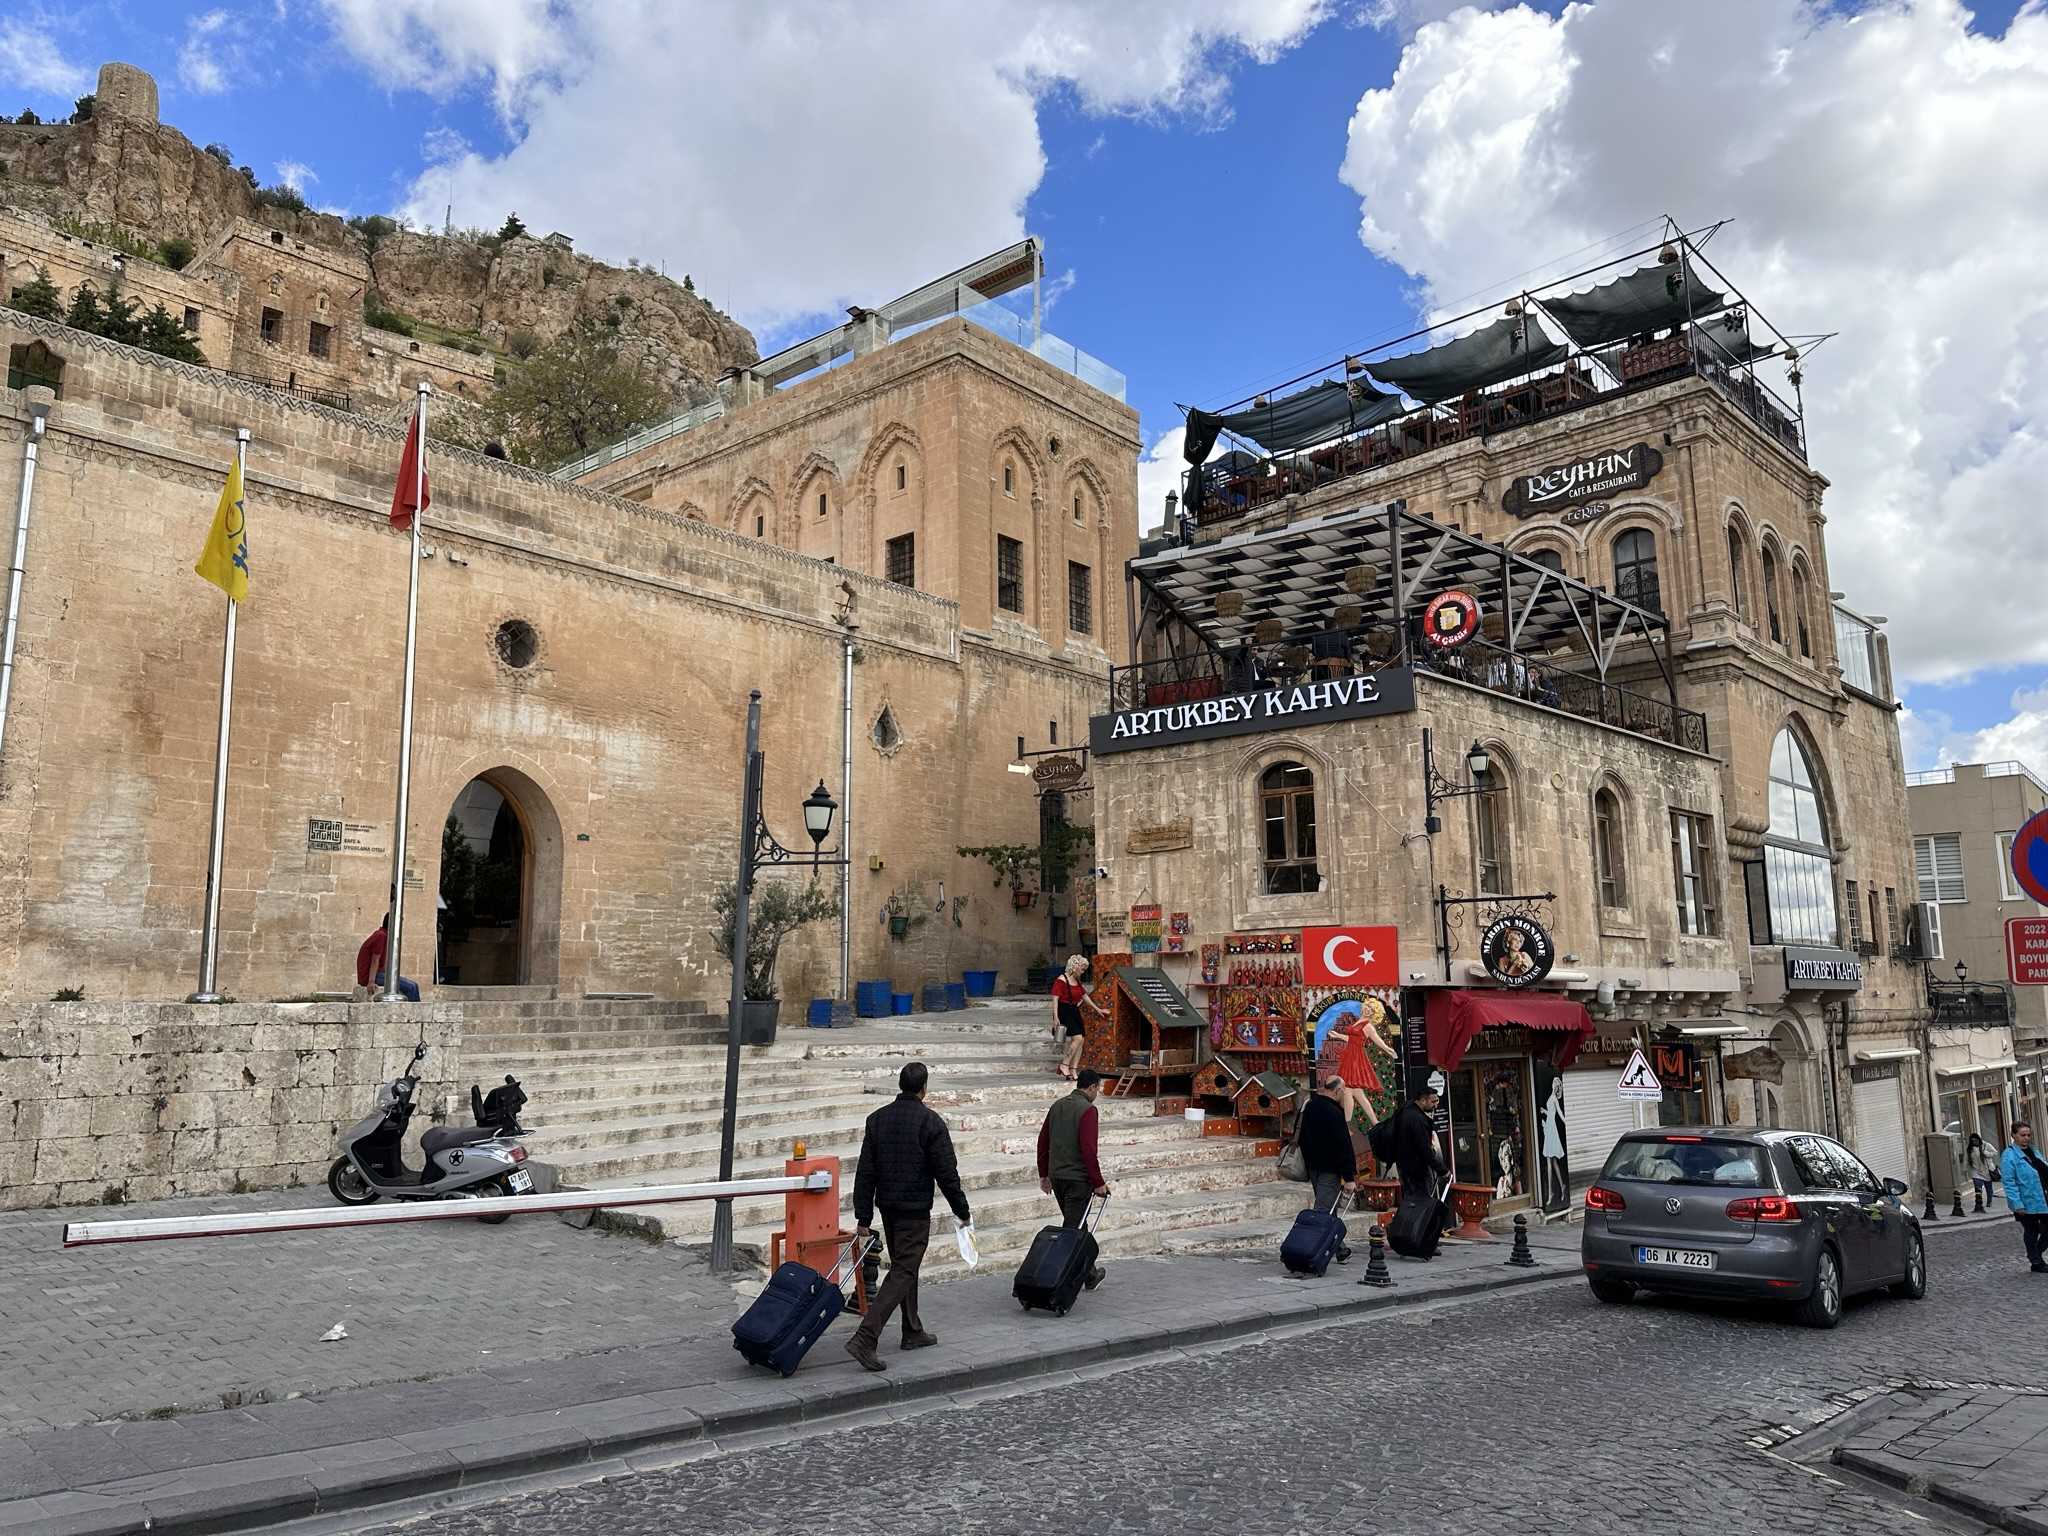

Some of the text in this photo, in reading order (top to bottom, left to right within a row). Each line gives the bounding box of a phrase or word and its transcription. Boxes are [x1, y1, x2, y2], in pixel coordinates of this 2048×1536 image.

[1527, 450, 1634, 502] REYHAN
[1569, 486, 1587, 498] CAFE
[1592, 472, 1638, 492] RESTAURANT
[1110, 674, 1380, 739] ARTUKBEY KAHVE
[1513, 919, 1546, 957] MONROE
[2024, 925, 2047, 935] 2022
[2020, 953, 2048, 964] BOYU
[1793, 959, 1863, 980] ARTUKBEY KAHVE
[2028, 968, 2048, 979] PAR
[1646, 1249, 1710, 1267] 06 AK 2223
